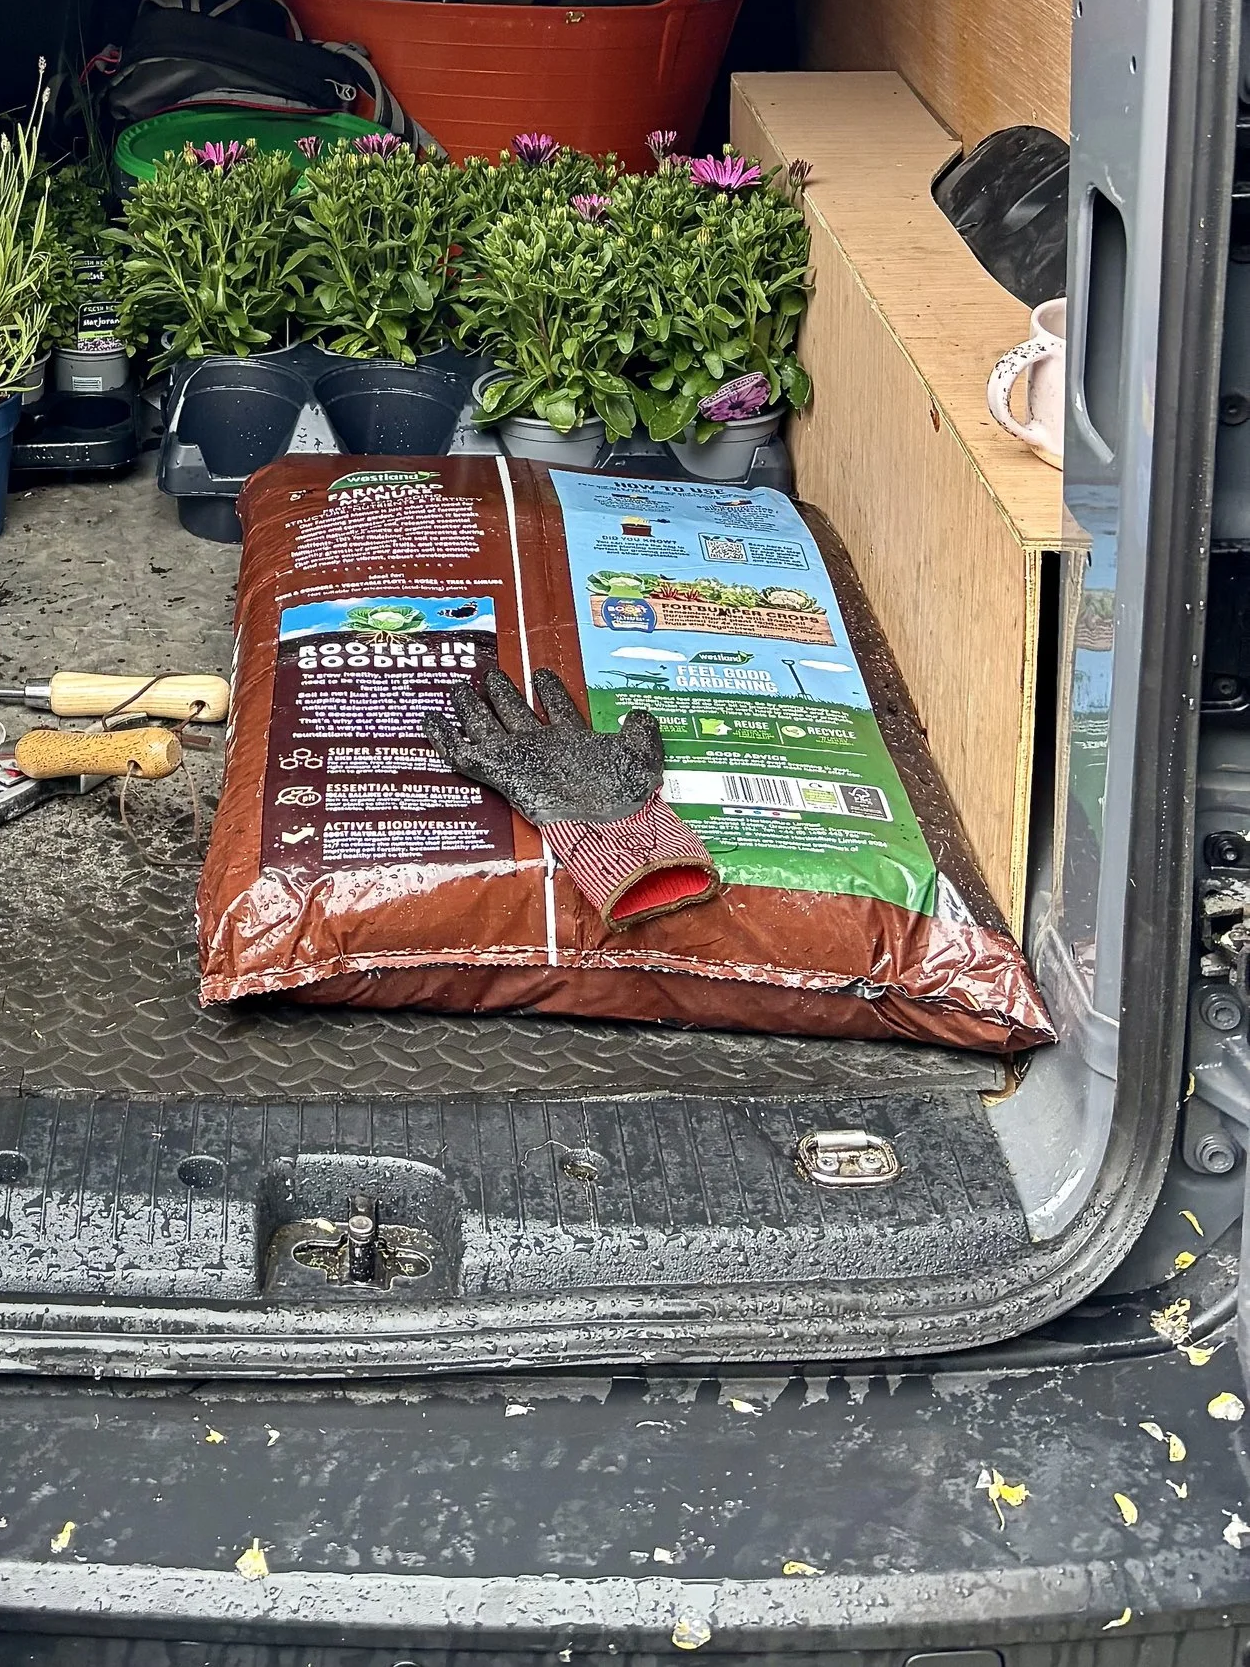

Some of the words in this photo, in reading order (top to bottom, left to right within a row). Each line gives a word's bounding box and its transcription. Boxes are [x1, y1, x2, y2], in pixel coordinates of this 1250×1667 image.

[89, 272, 105, 280] int
[347, 473, 419, 483] westland
[328, 483, 444, 502] FARMYARD
[614, 482, 655, 492] HOW
[660, 485, 686, 493] TO
[690, 487, 726, 495] USE
[339, 487, 434, 506] MANURE
[608, 606, 648, 614] BOOST
[693, 605, 762, 617] BUMPER
[765, 612, 820, 624] CROPS
[299, 643, 428, 657] ROOTED
[441, 642, 475, 655] IN
[297, 655, 477, 669] GOODNESS
[699, 653, 742, 663] westland
[317, 673, 343, 681] grow
[344, 671, 382, 680] healthy,
[384, 672, 415, 681] happy
[417, 671, 448, 681] plants
[450, 671, 472, 680] they
[677, 664, 717, 678] FEEL
[722, 667, 771, 682] GOOD
[402, 678, 432, 687] good,
[676, 675, 779, 694] GARDENING
[360, 684, 390, 692] fertile
[392, 684, 413, 692] soil.
[331, 690, 348, 698] not
[350, 691, 369, 700] just
[418, 691, 444, 700] plant
[304, 698, 347, 706] supplies
[349, 698, 397, 706] nutrients,
[302, 704, 336, 712] natural
[388, 704, 408, 712] and
[410, 704, 443, 712] allows
[366, 712, 403, 720] oxygen
[655, 716, 689, 726] DUCE
[333, 718, 353, 726] why
[733, 720, 770, 730] REUSE
[338, 725, 367, 733] ways
[806, 726, 856, 739] RECYCLE
[372, 732, 400, 740] your
[402, 731, 428, 740] plant
[328, 747, 370, 756] SUPER
[374, 747, 439, 758] STRUCTU
[706, 750, 741, 758] GOOD
[744, 753, 788, 762] ADVICE
[429, 758, 444, 766] MAT
[326, 783, 398, 792] ESSENTIAL
[402, 784, 480, 794] NUTRITION
[324, 822, 373, 832] ACTIVE
[378, 820, 478, 830] BIODIVERSITY
